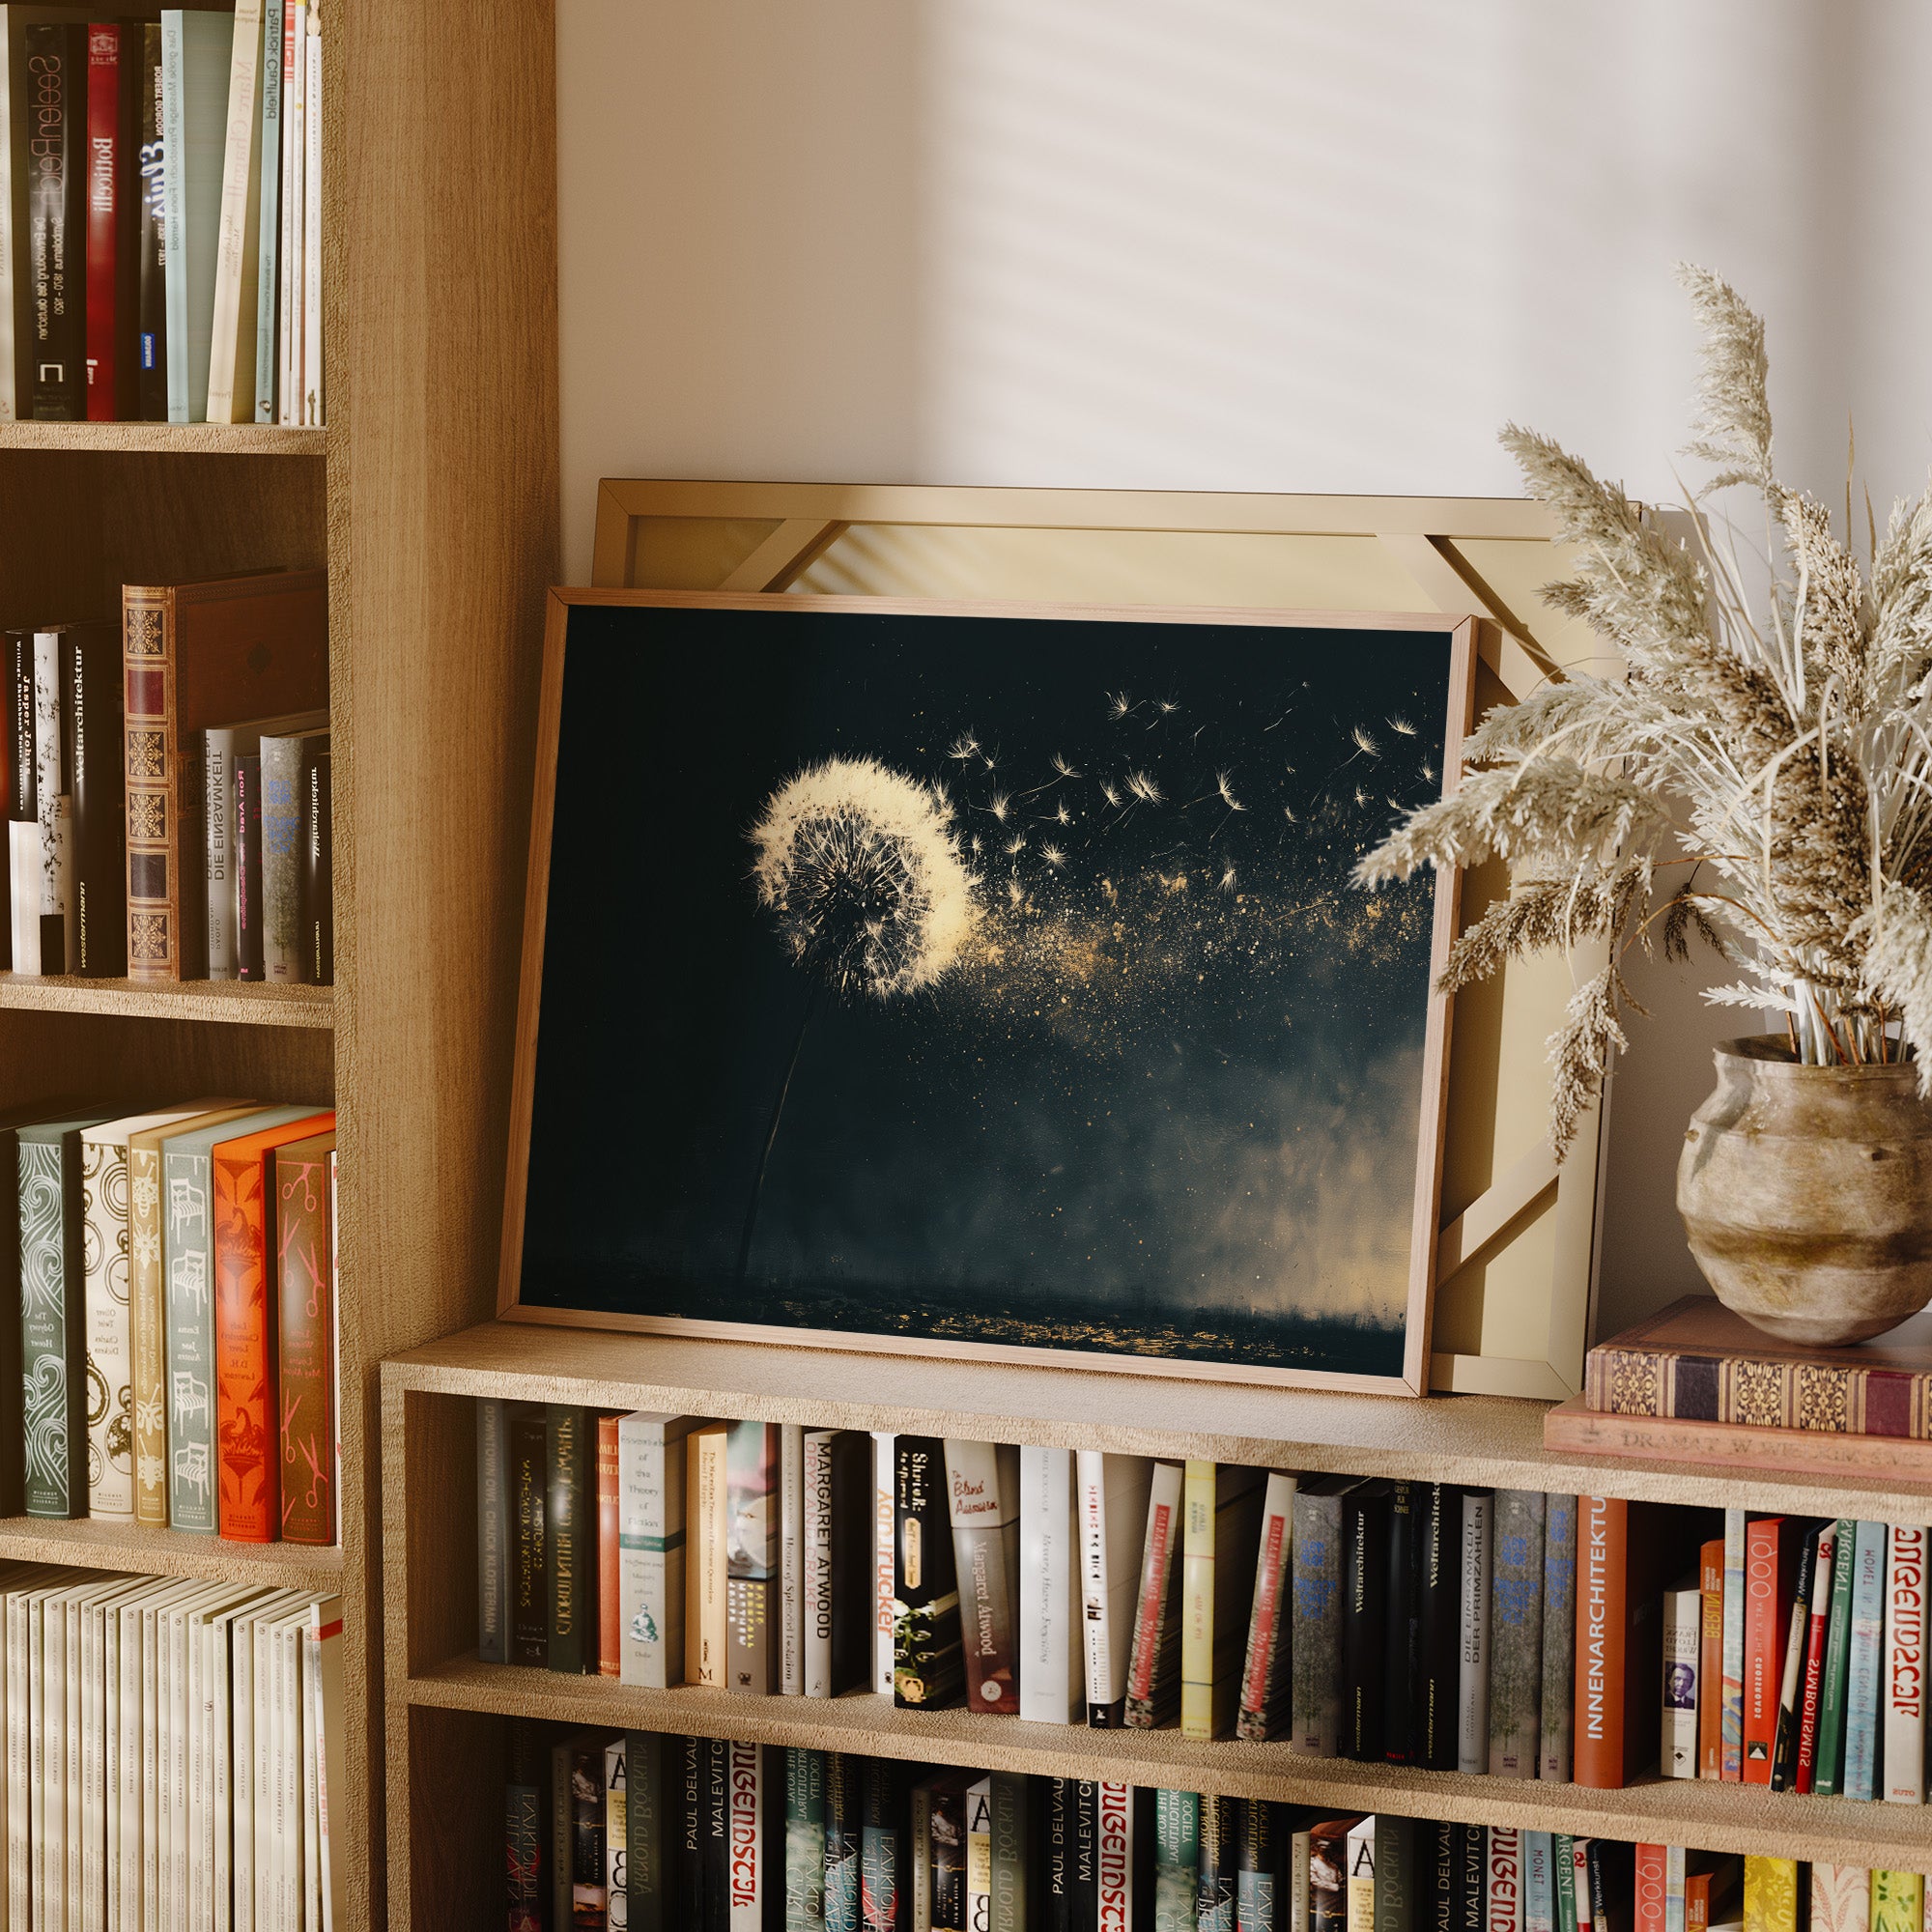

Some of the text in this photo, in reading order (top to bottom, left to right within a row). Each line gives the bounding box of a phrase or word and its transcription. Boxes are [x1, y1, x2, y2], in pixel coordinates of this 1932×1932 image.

[22, 675, 32, 777] Jasper Johns
[74, 645, 84, 783] Weltarchitektur
[484, 1405, 496, 1633] DOWNTOWN OWL CHUCK KLOSTERMAN
[628, 1518, 659, 1528] Fiction
[629, 1486, 659, 1496] Theory
[806, 1441, 816, 1612] ORYX AND CRAKE
[953, 1480, 984, 1497] Blind
[816, 1442, 832, 1639] MARGARET ATWOOD
[1355, 1511, 1365, 1614] Weltarchitektur
[1463, 1520, 1474, 1663] DIE EINSAMKEIT
[1473, 1505, 1484, 1622] PRIMZAHLEN
[973, 1542, 997, 1657] Margaret Atwood
[1587, 1496, 1607, 1739] INNENARCHITEKTU
[698, 1667, 714, 1681] M
[687, 1735, 697, 1851] PAUL DELVAU
[1052, 1776, 1064, 1895] PAUL DELVAU
[1352, 1838, 1375, 1877] A
[1437, 1821, 1450, 1897] DELVAU
[1533, 1849, 1544, 1886] MONET
[1557, 1833, 1574, 1899] ARGENT
[1637, 1857, 1662, 1919] 1900
